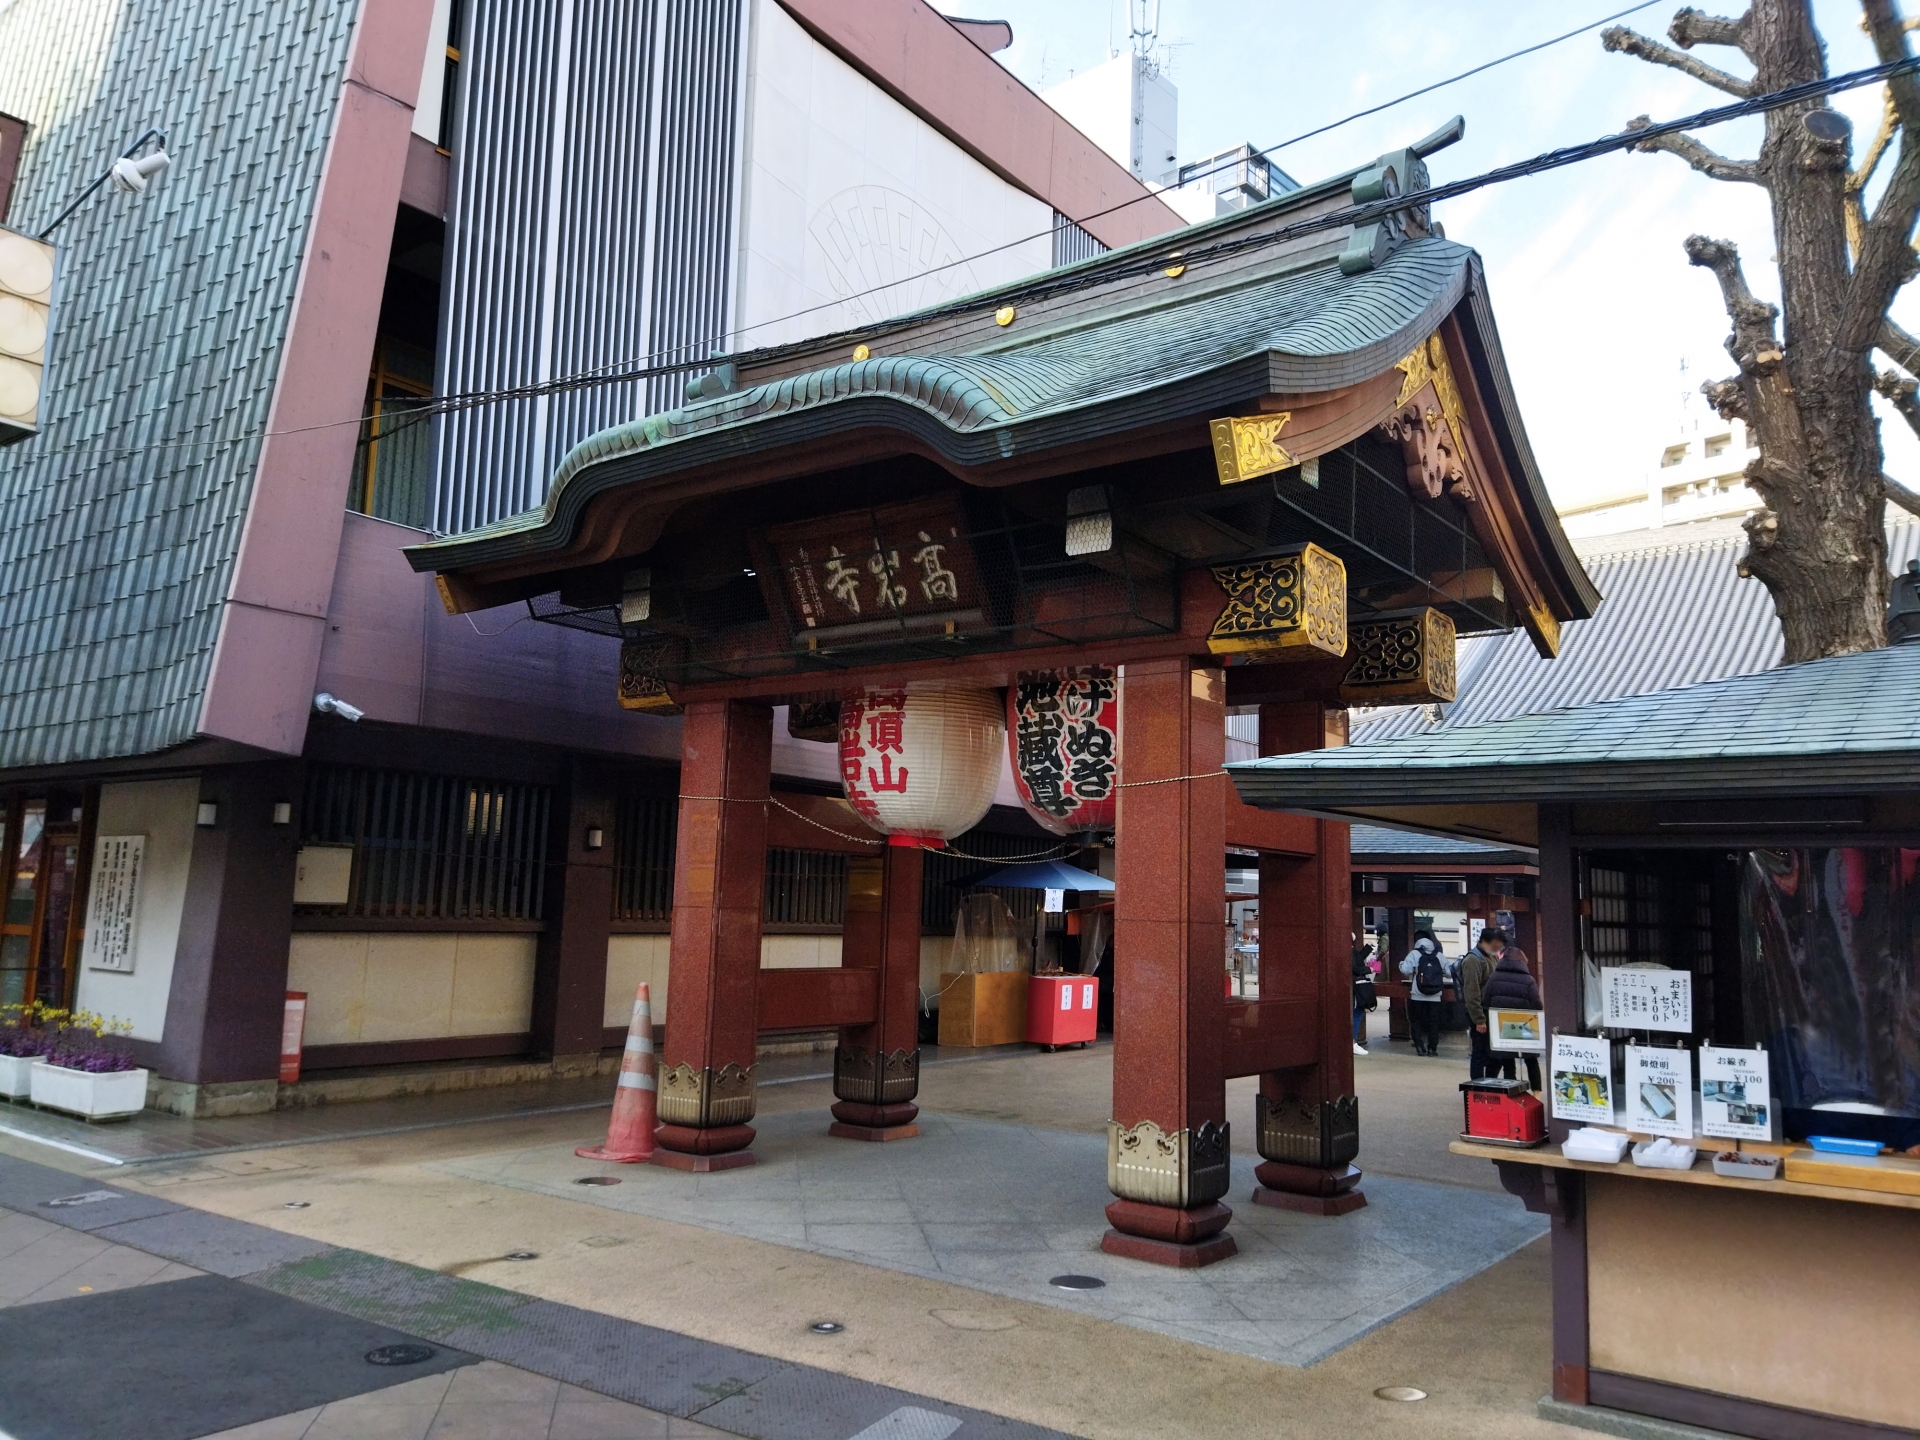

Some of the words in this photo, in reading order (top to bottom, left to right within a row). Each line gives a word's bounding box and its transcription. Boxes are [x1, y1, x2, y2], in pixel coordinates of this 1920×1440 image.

[1670, 979, 1681, 1019] おまいり
[1660, 996, 1670, 1022] セット
[1558, 1049, 1599, 1059] おみぬぐい
[1639, 1059, 1669, 1070] 御燈明
[1717, 1056, 1747, 1067] お線香
